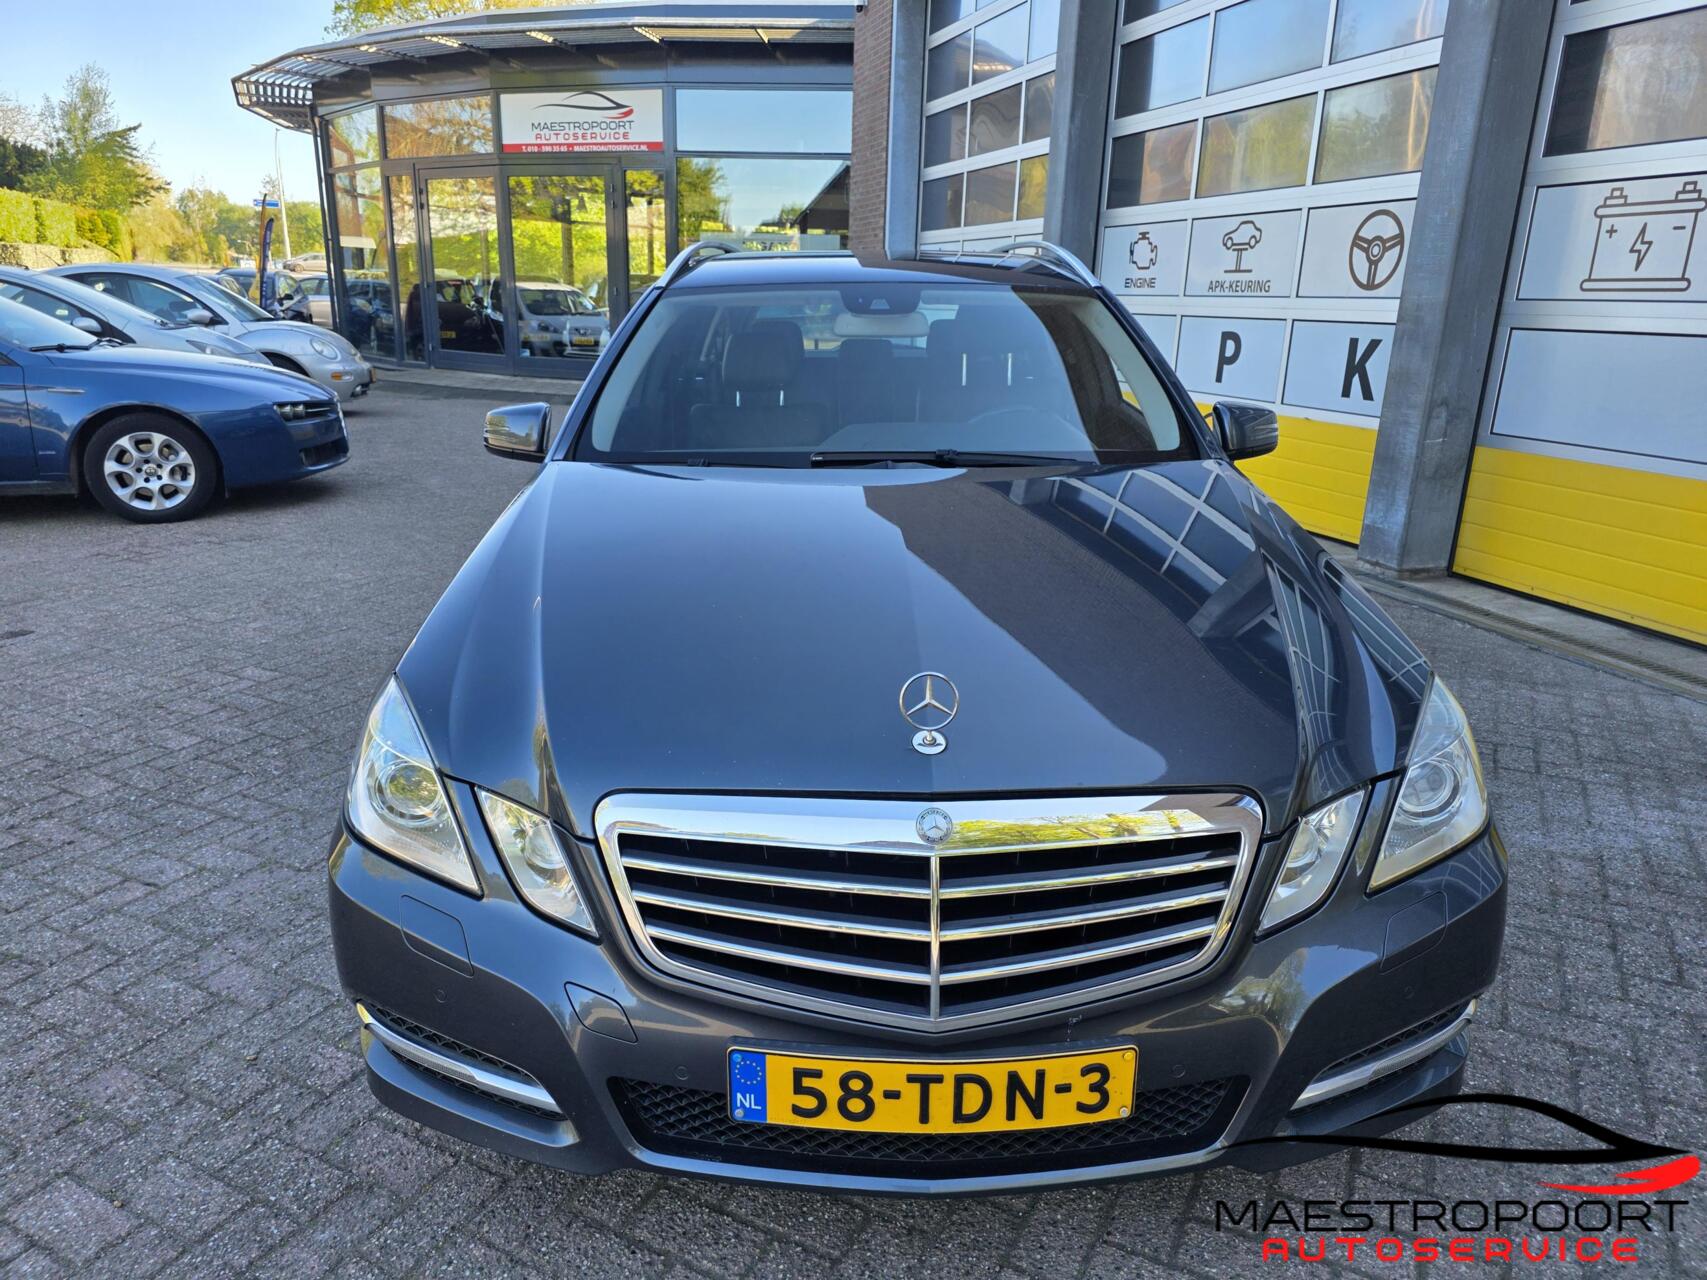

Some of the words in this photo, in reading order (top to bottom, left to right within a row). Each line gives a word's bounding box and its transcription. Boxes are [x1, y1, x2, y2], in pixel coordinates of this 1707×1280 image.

[531, 121, 634, 132] MAESTROPOORT
[535, 132, 630, 141] AUTOSERVICE
[1124, 277, 1156, 289] ENGINE
[1207, 279, 1271, 293] APK-KEURING
[1215, 331, 1242, 383] P
[1340, 337, 1383, 401] K
[736, 1092, 761, 1110] NL
[790, 1063, 1112, 1125] 58-TDN-3
